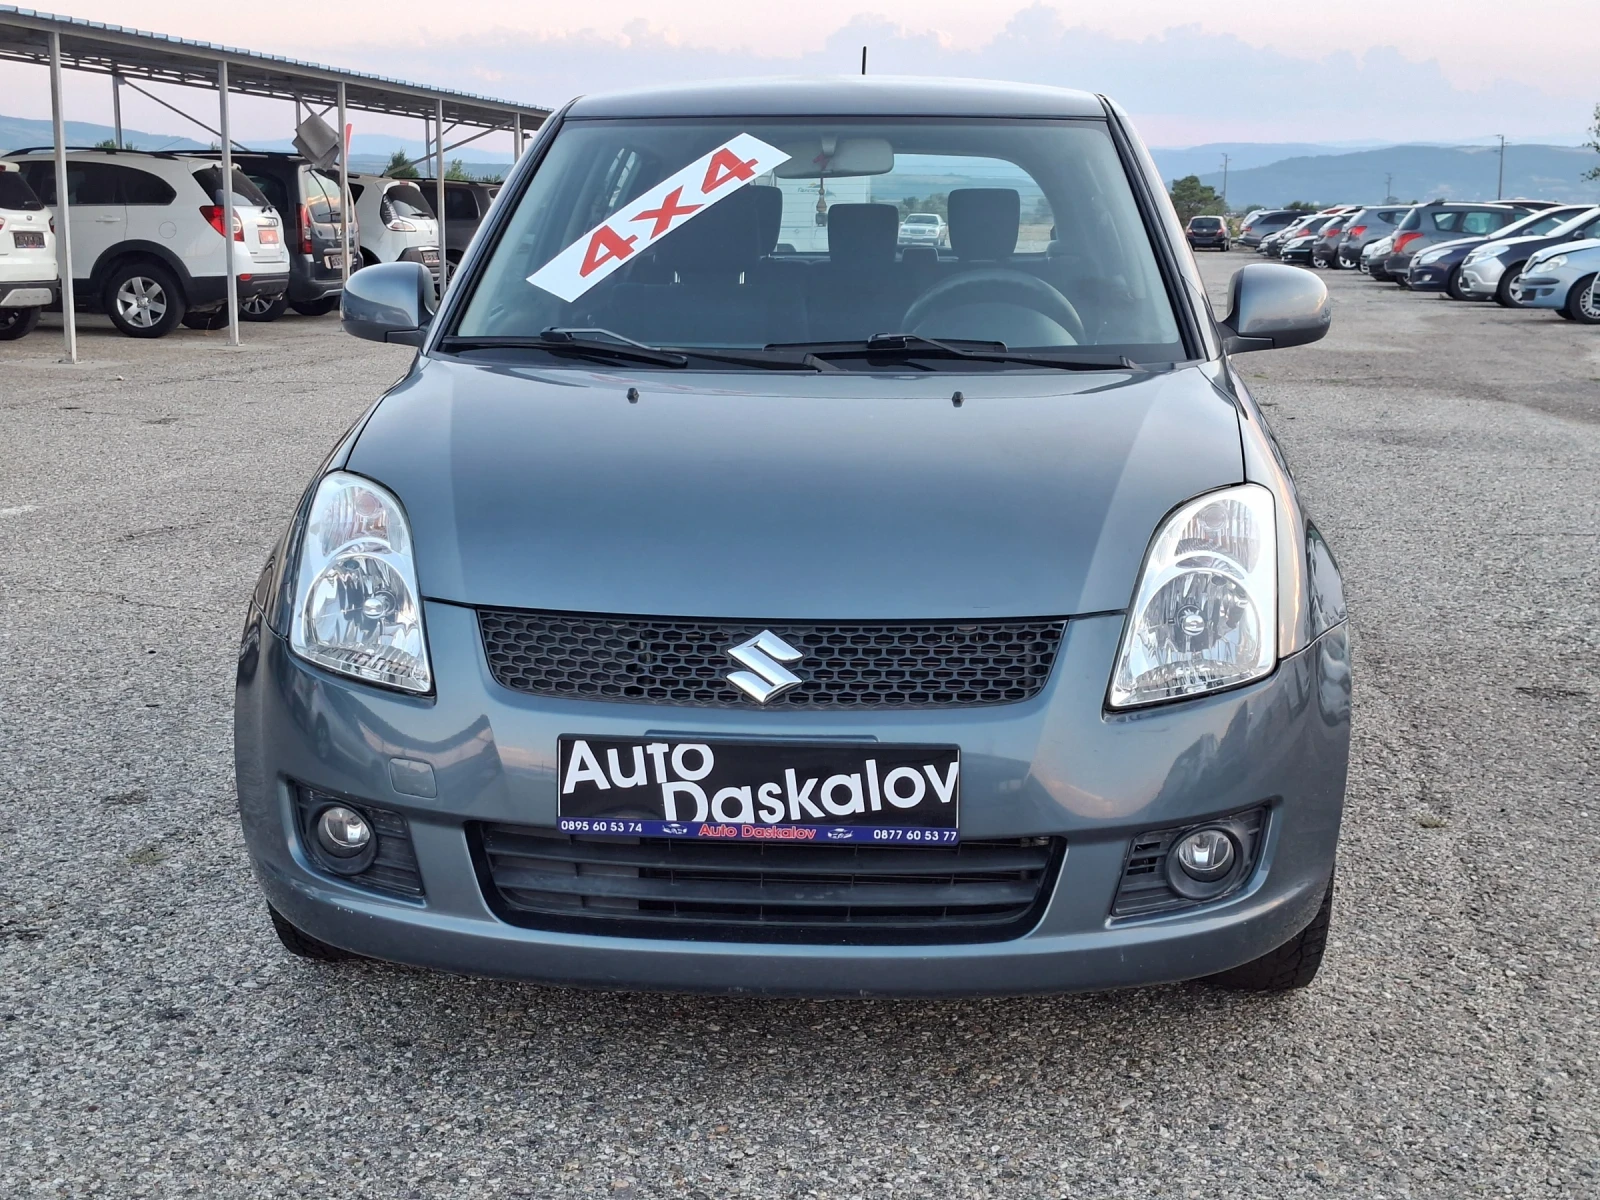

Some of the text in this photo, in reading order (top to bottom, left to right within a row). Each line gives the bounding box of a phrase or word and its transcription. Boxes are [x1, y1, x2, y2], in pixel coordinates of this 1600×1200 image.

[562, 740, 715, 794] Auto
[661, 759, 958, 824] Daskalov
[561, 820, 642, 832] 0895 60 53 74
[698, 823, 817, 840] Auto Daskalov
[873, 829, 958, 842] 0877 60 53 77
